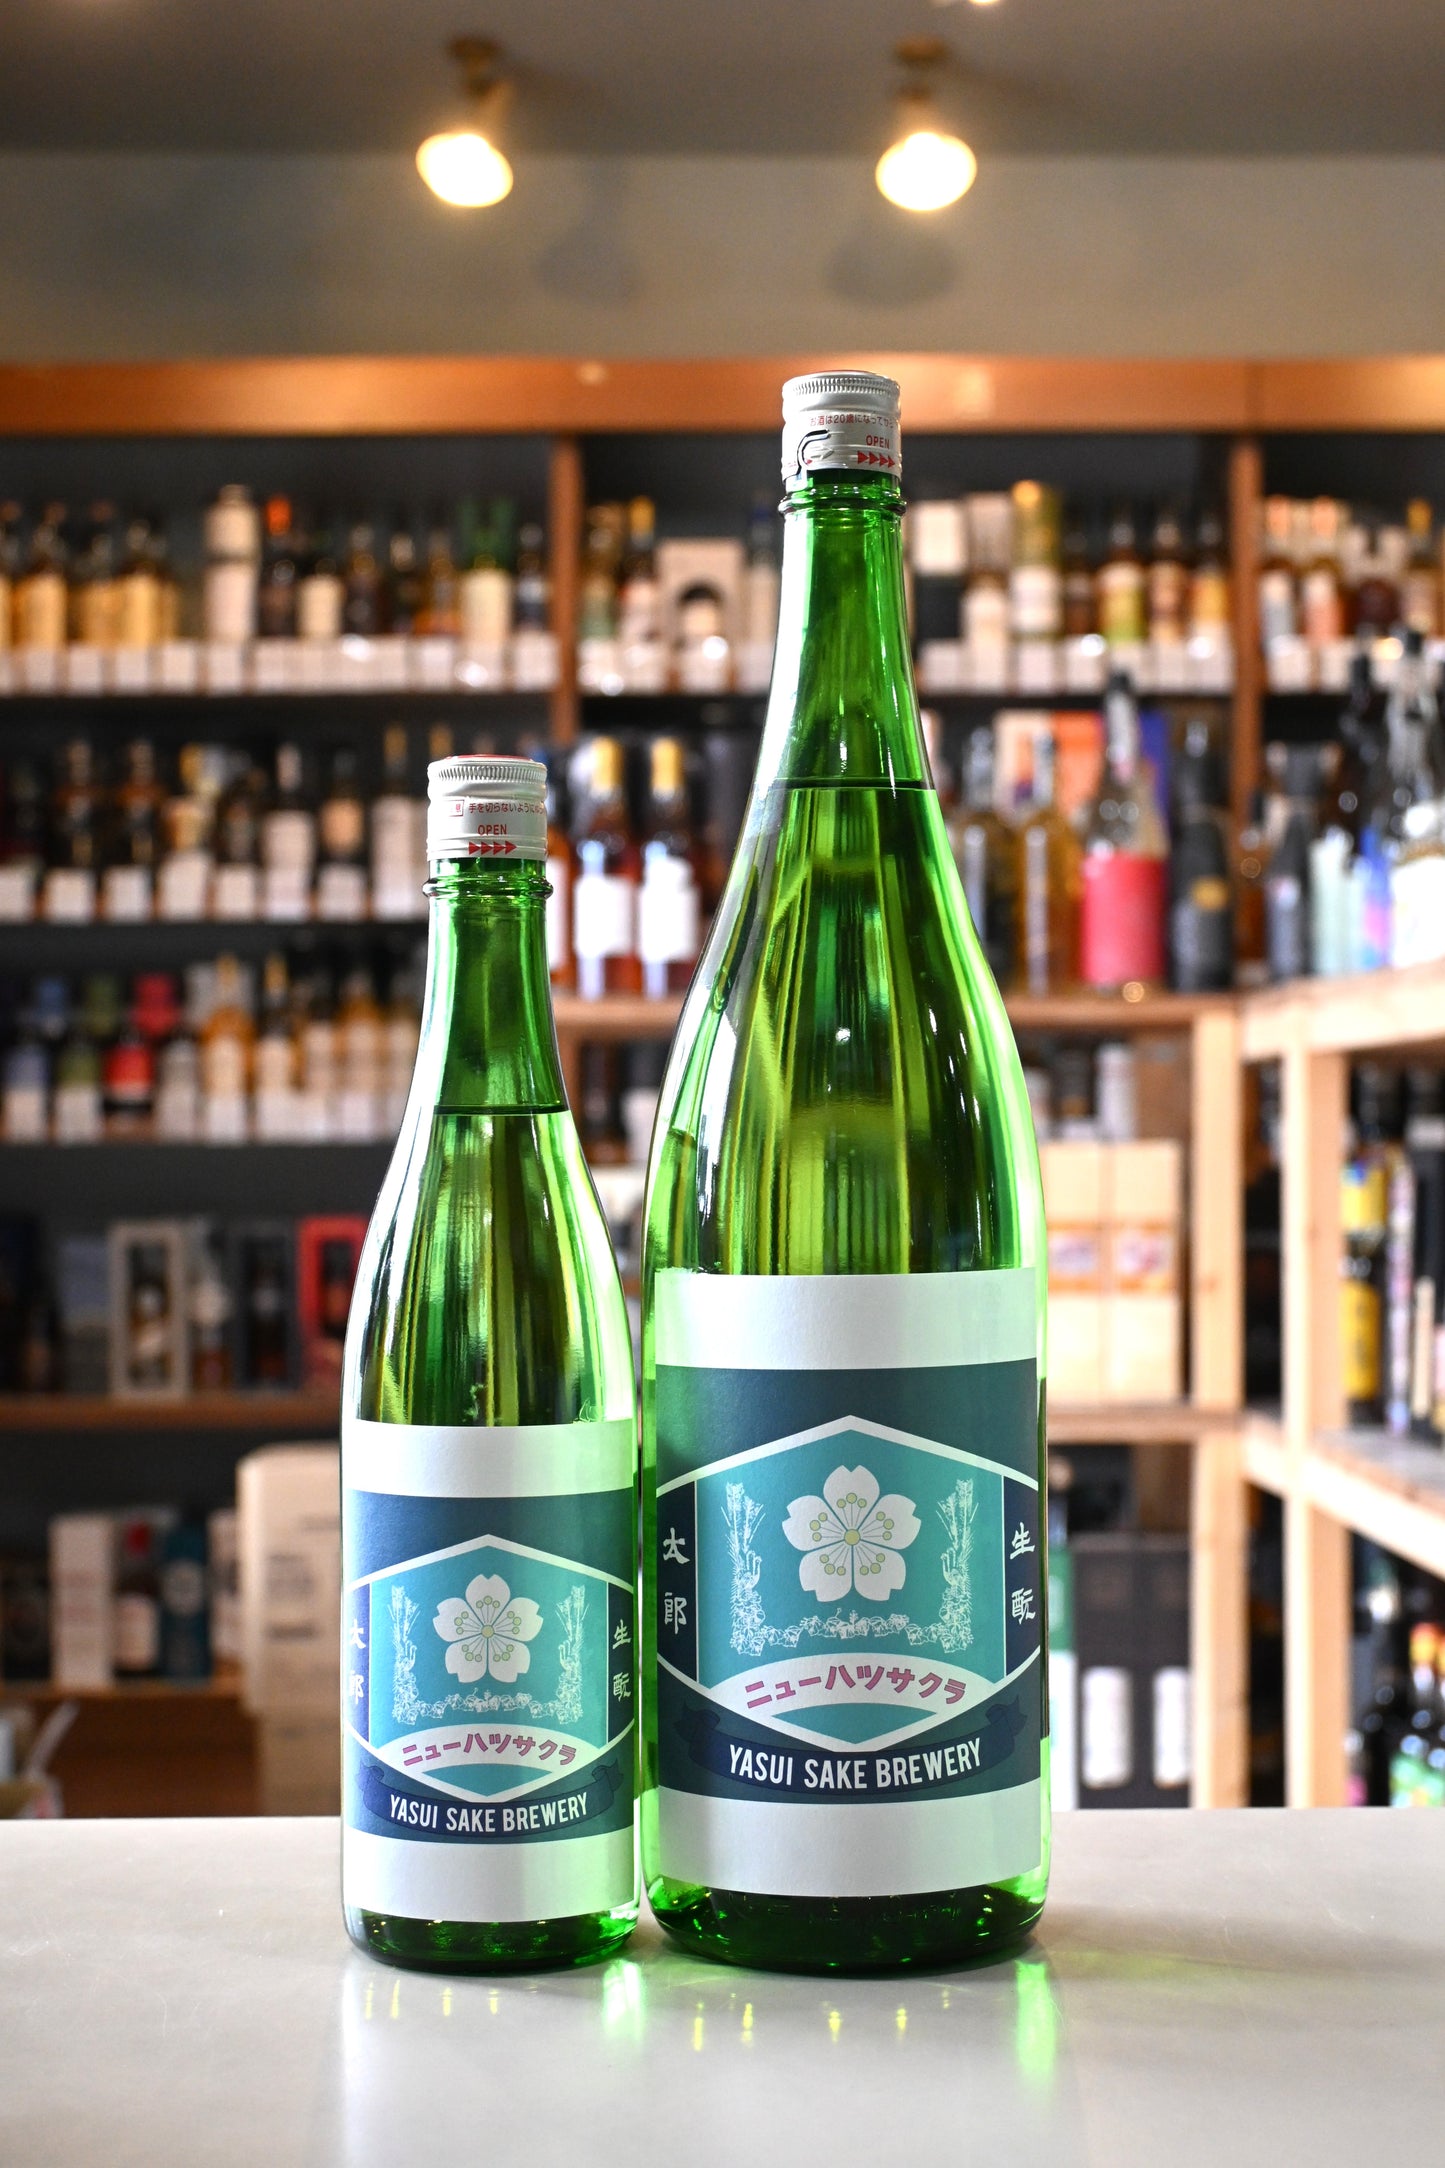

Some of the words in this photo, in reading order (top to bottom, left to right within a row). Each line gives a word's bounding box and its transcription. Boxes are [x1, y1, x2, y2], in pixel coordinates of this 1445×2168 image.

[810, 413, 894, 429] お酒は20歳になってから
[866, 434, 890, 449] OPEN
[477, 824, 507, 836] OPEN
[663, 1527, 690, 1634] 太郎
[745, 1665, 968, 1709] ニューハツサクラ
[402, 1733, 577, 1766] ニューハツサクラ
[729, 1744, 793, 1786] YASUI
[804, 1759, 867, 1790] SAKE
[875, 1738, 982, 1788] BREWERY
[390, 1794, 438, 1828] YASUI
[446, 1807, 496, 1832] SAKE
[502, 1792, 588, 1830] BREWERY
